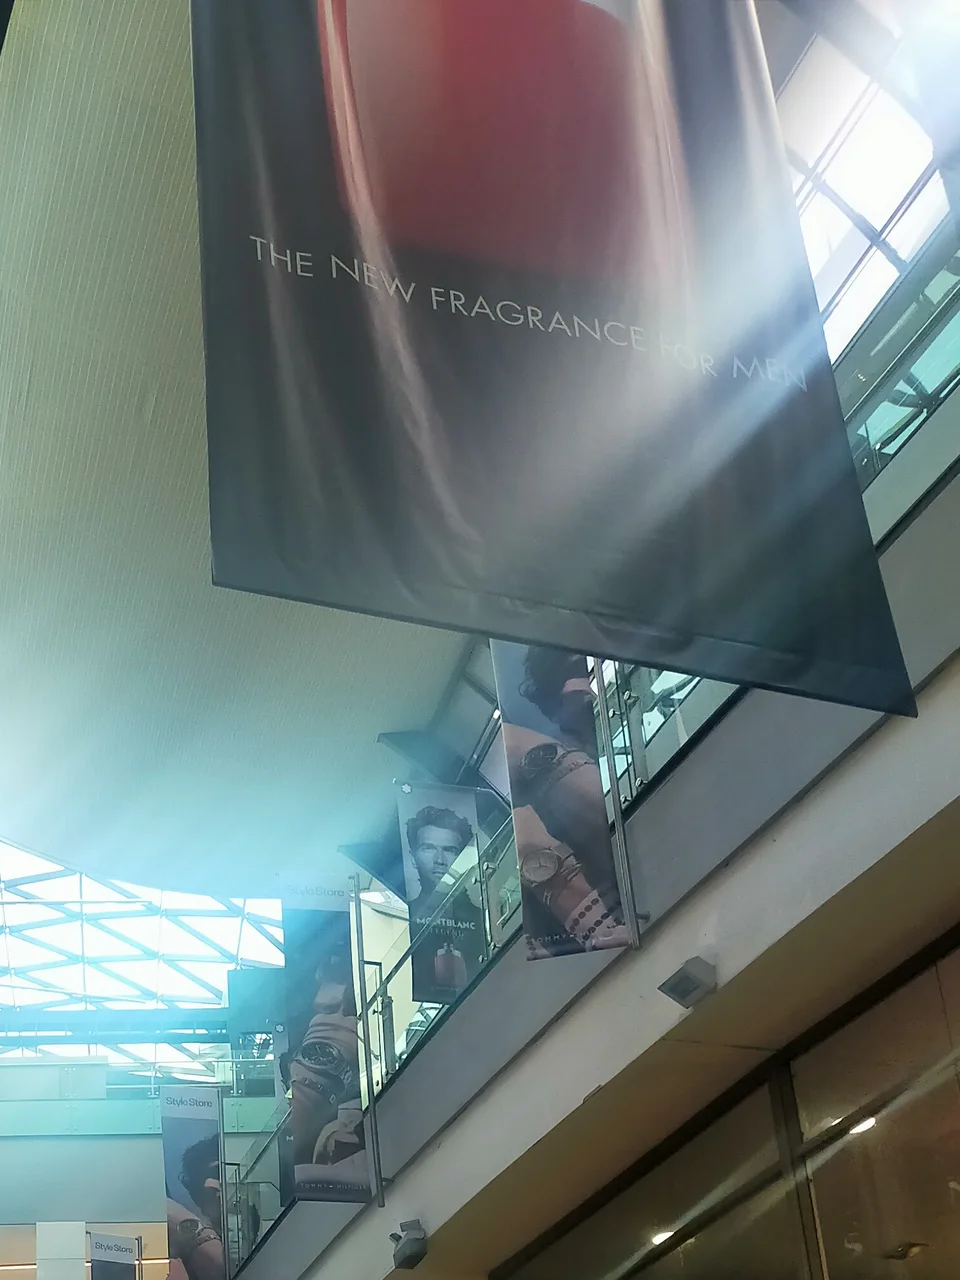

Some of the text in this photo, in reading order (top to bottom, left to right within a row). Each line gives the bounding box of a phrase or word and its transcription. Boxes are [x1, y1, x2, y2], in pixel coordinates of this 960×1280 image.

[249, 235, 808, 392] THE NEW FRAGRANCE FOR MEN
